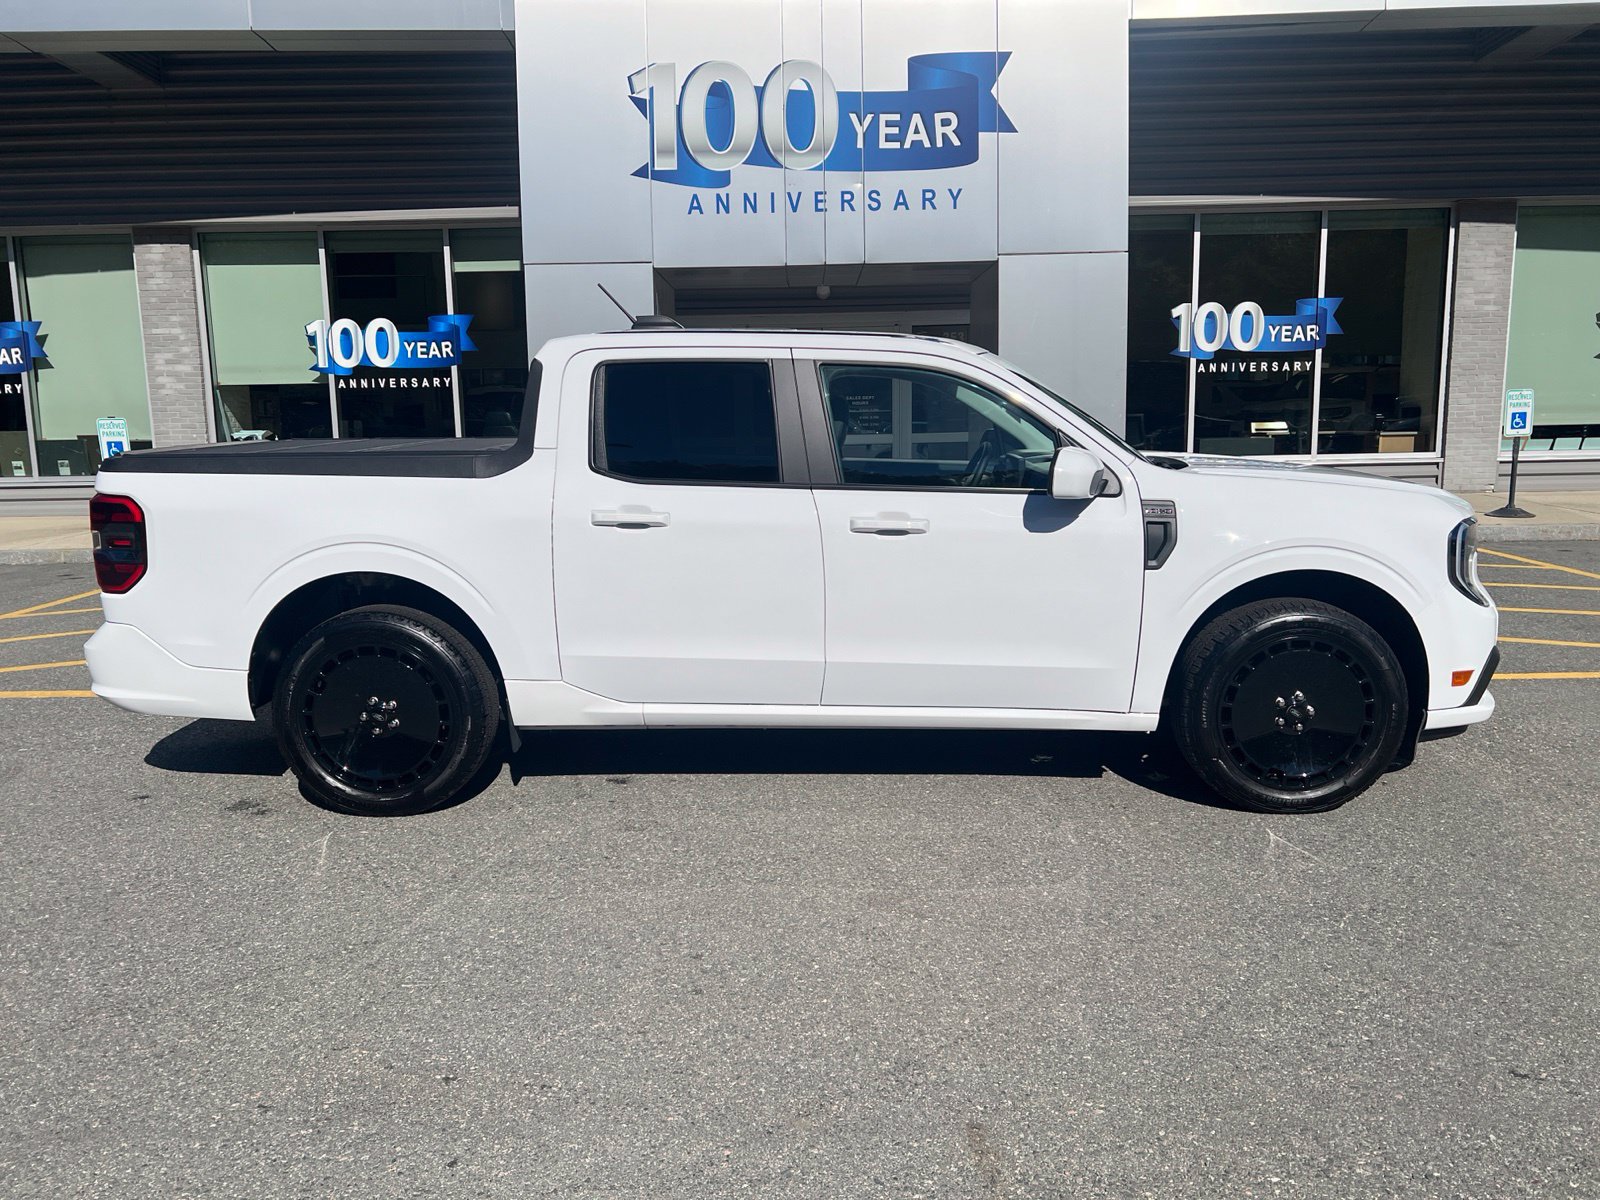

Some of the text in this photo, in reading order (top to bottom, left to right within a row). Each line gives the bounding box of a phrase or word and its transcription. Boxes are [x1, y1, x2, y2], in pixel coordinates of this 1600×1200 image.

[627, 60, 962, 171] 100 YEAR
[687, 188, 964, 215] ANNIVERSARY
[1170, 301, 1320, 352] 100 YEAR
[305, 317, 454, 369] 100 YEAR
[1197, 361, 1313, 373] ANNIVERSARY
[338, 377, 451, 389] ANNIVERSARY
[99, 422, 126, 430] RESERVED
